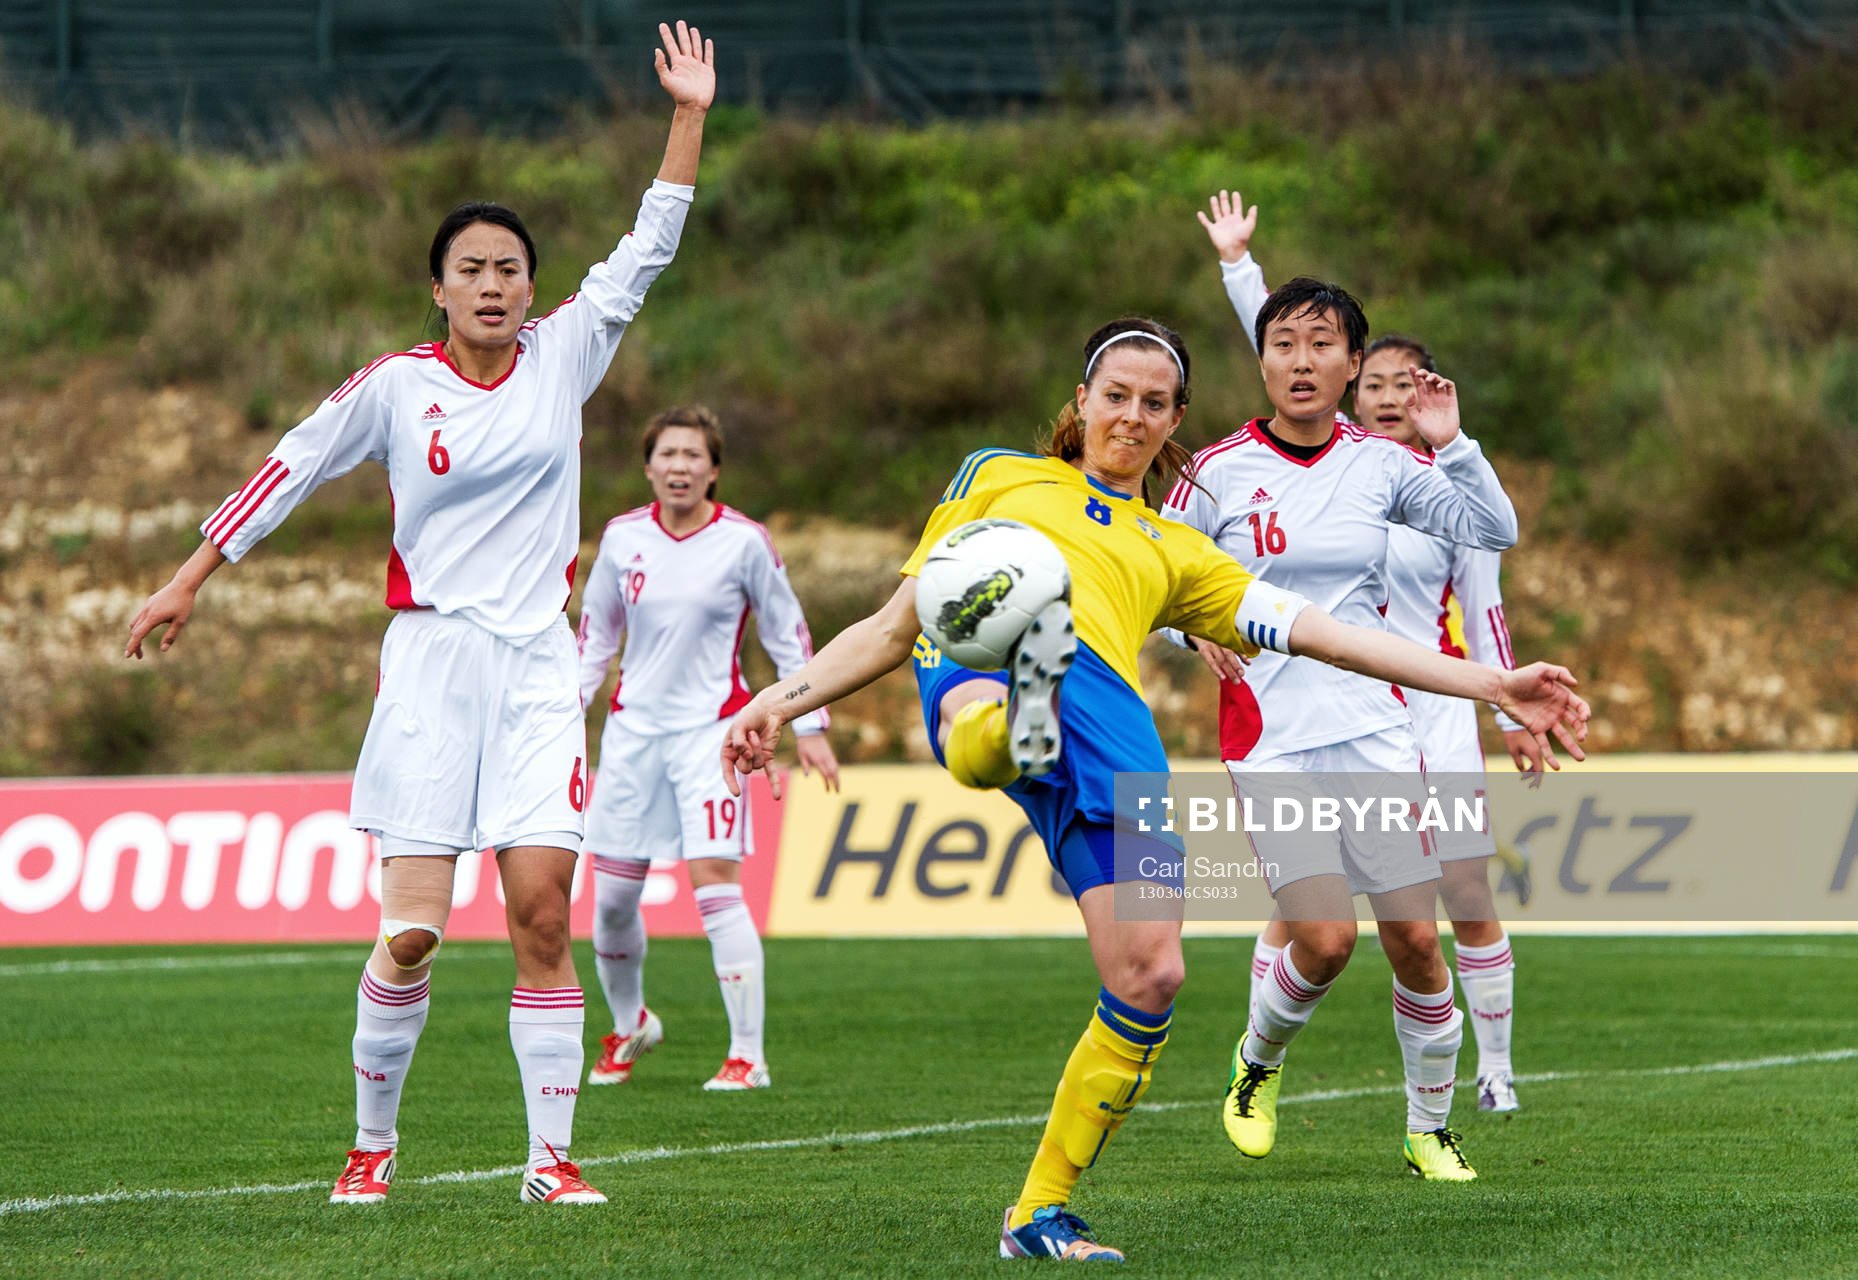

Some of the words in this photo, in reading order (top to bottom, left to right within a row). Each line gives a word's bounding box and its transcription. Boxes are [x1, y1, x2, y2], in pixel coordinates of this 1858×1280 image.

[428, 429, 451, 475] 6
[1085, 496, 1112, 526] 8
[1248, 511, 1287, 558] 16
[625, 569, 645, 605] 19
[568, 757, 584, 813] 6
[704, 798, 736, 840] 19
[813, 801, 1074, 898] Her
